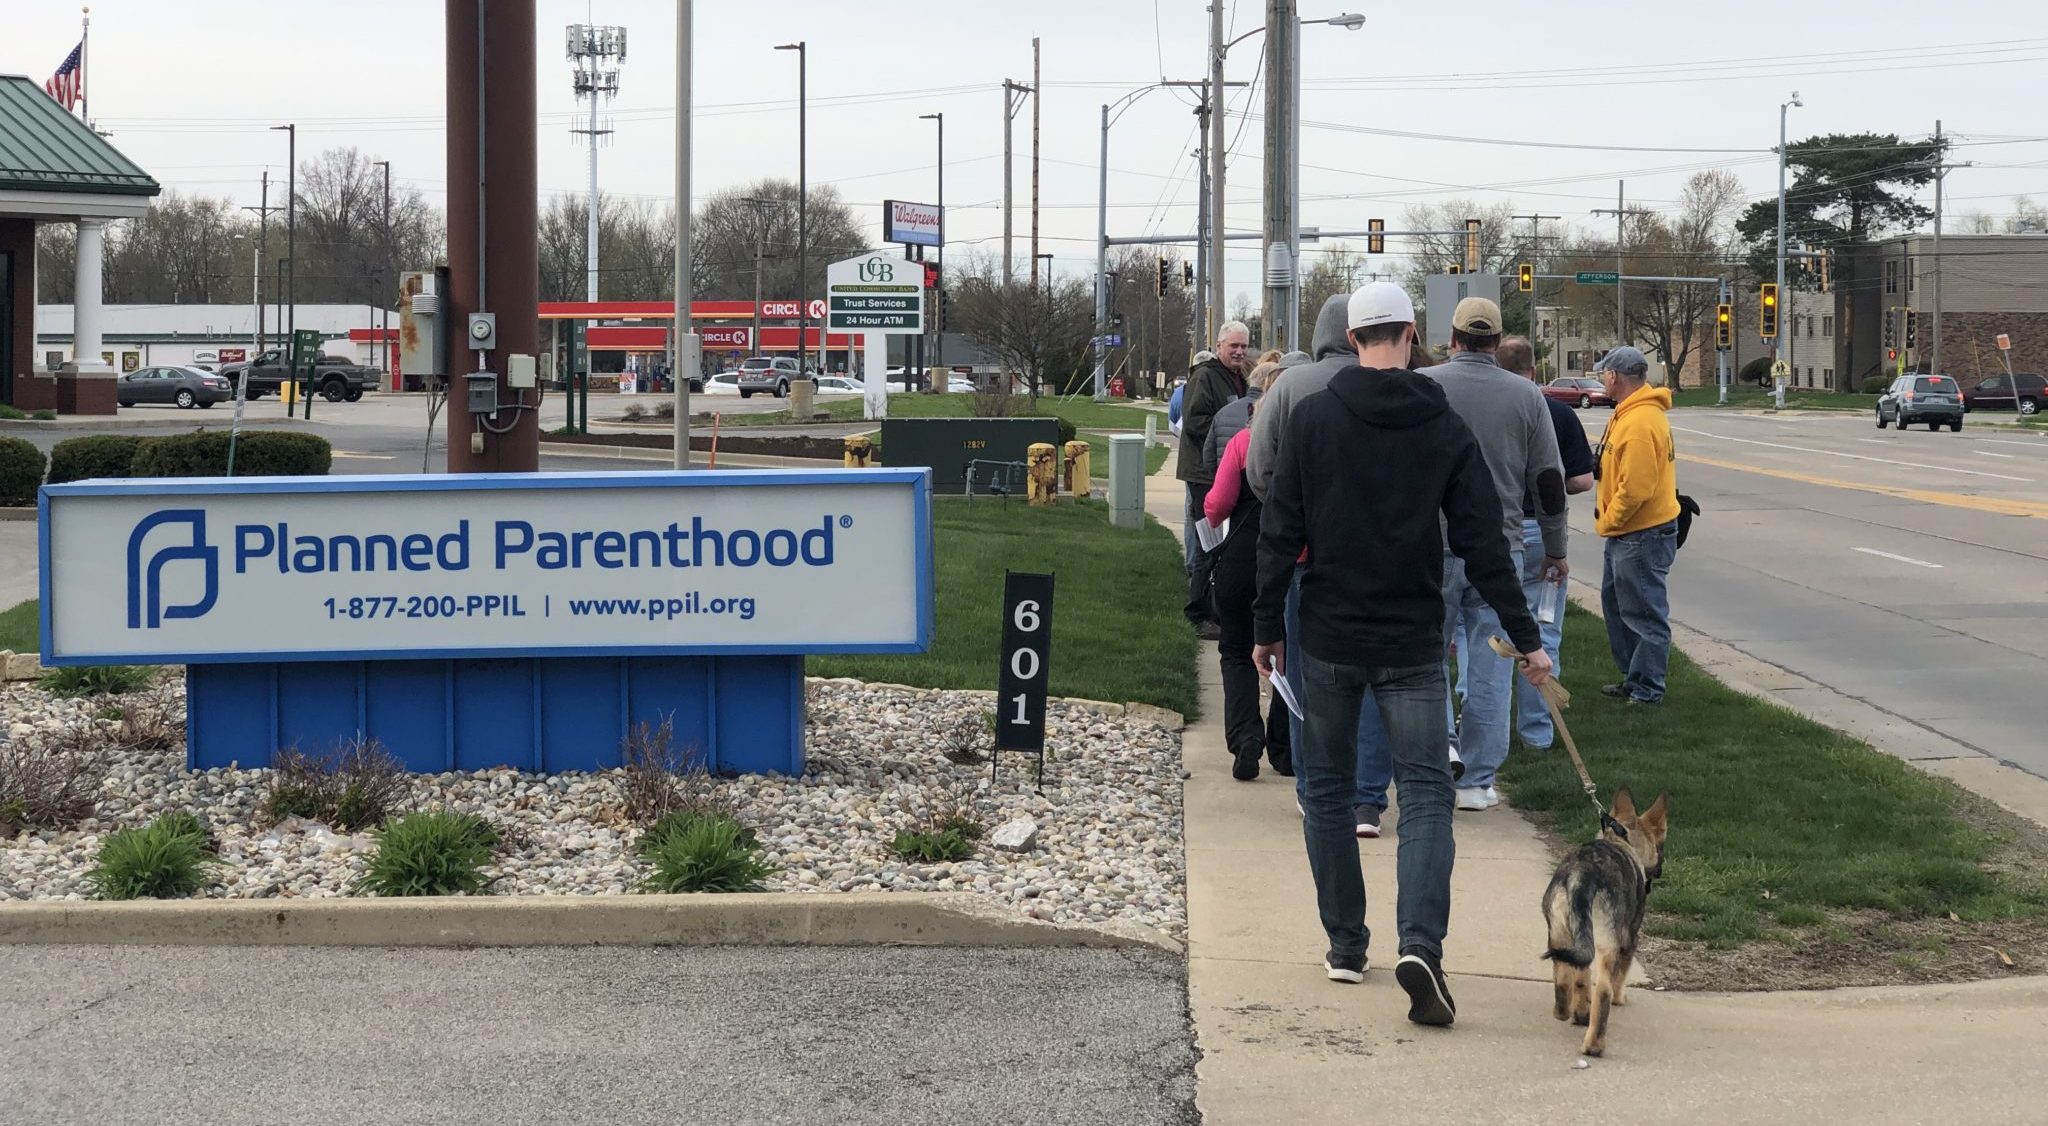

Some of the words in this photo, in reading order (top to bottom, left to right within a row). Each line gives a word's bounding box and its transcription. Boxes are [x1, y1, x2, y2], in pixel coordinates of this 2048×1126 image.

[844, 299, 866, 307] Trust
[868, 299, 906, 307] Services
[763, 303, 807, 315] CIRCL
[846, 316, 857, 325] 24
[859, 316, 881, 325] Hour
[883, 316, 904, 325] ATM
[702, 333, 731, 342] IRCLE
[235, 519, 470, 574] Planned
[323, 594, 526, 620] 1-877-200-PPIL
[569, 591, 756, 621] www.ppil.org
